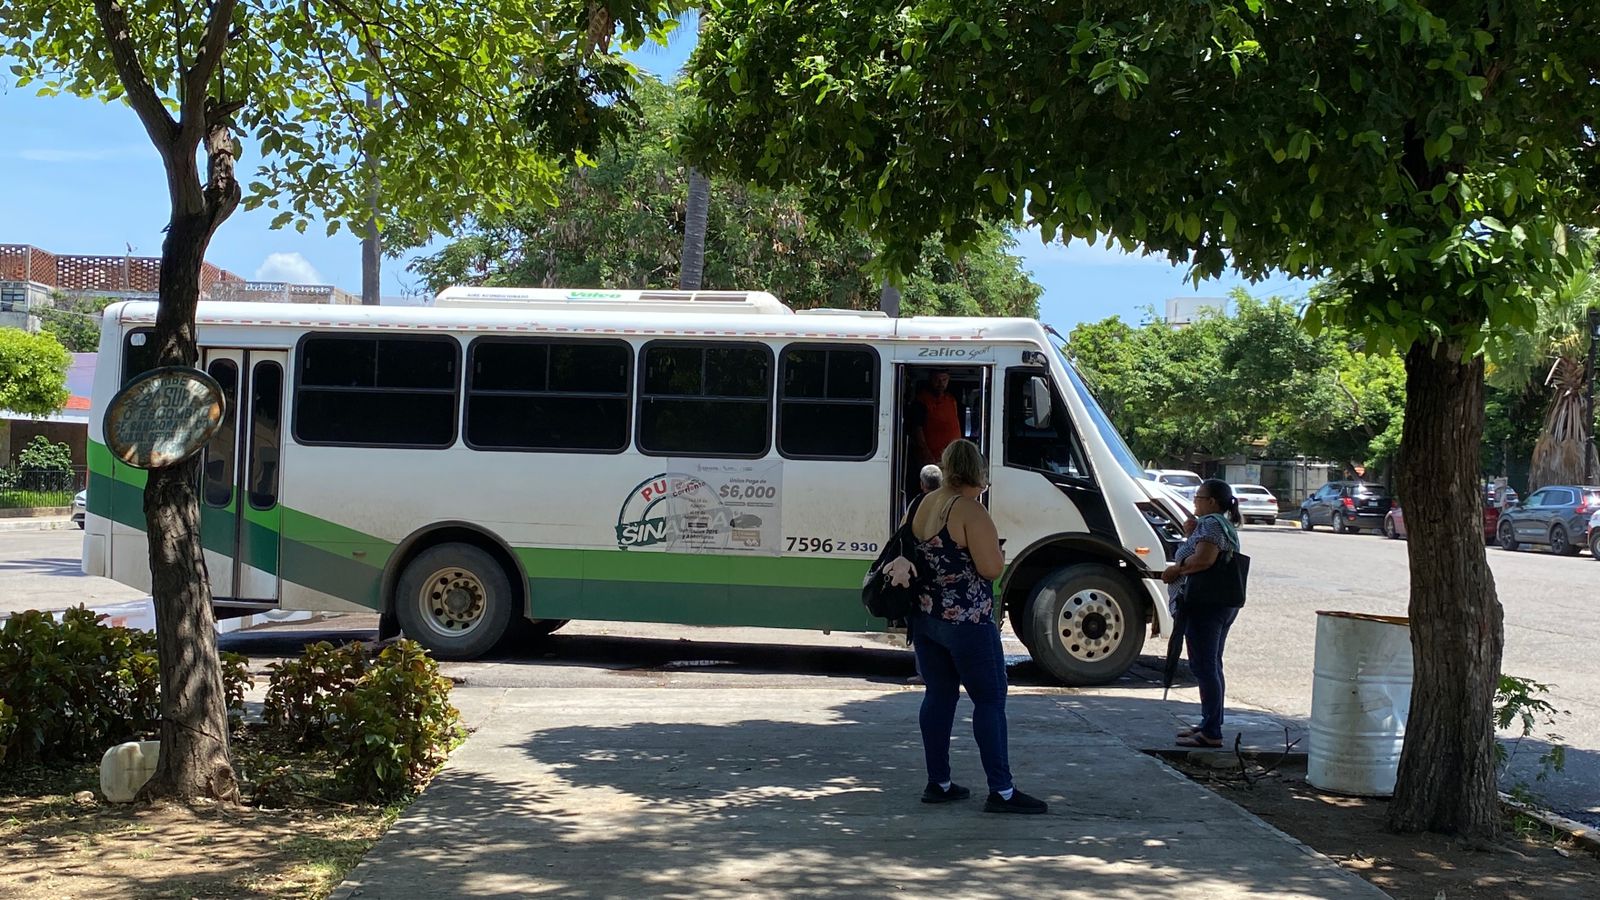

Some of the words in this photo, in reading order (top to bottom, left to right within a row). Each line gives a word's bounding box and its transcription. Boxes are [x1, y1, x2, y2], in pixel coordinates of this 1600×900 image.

[918, 347, 966, 357] Zafiro
[720, 484, 776, 500] $6,000
[786, 537, 833, 553] 7596
[836, 541, 847, 551] Z
[850, 542, 878, 552] 930
